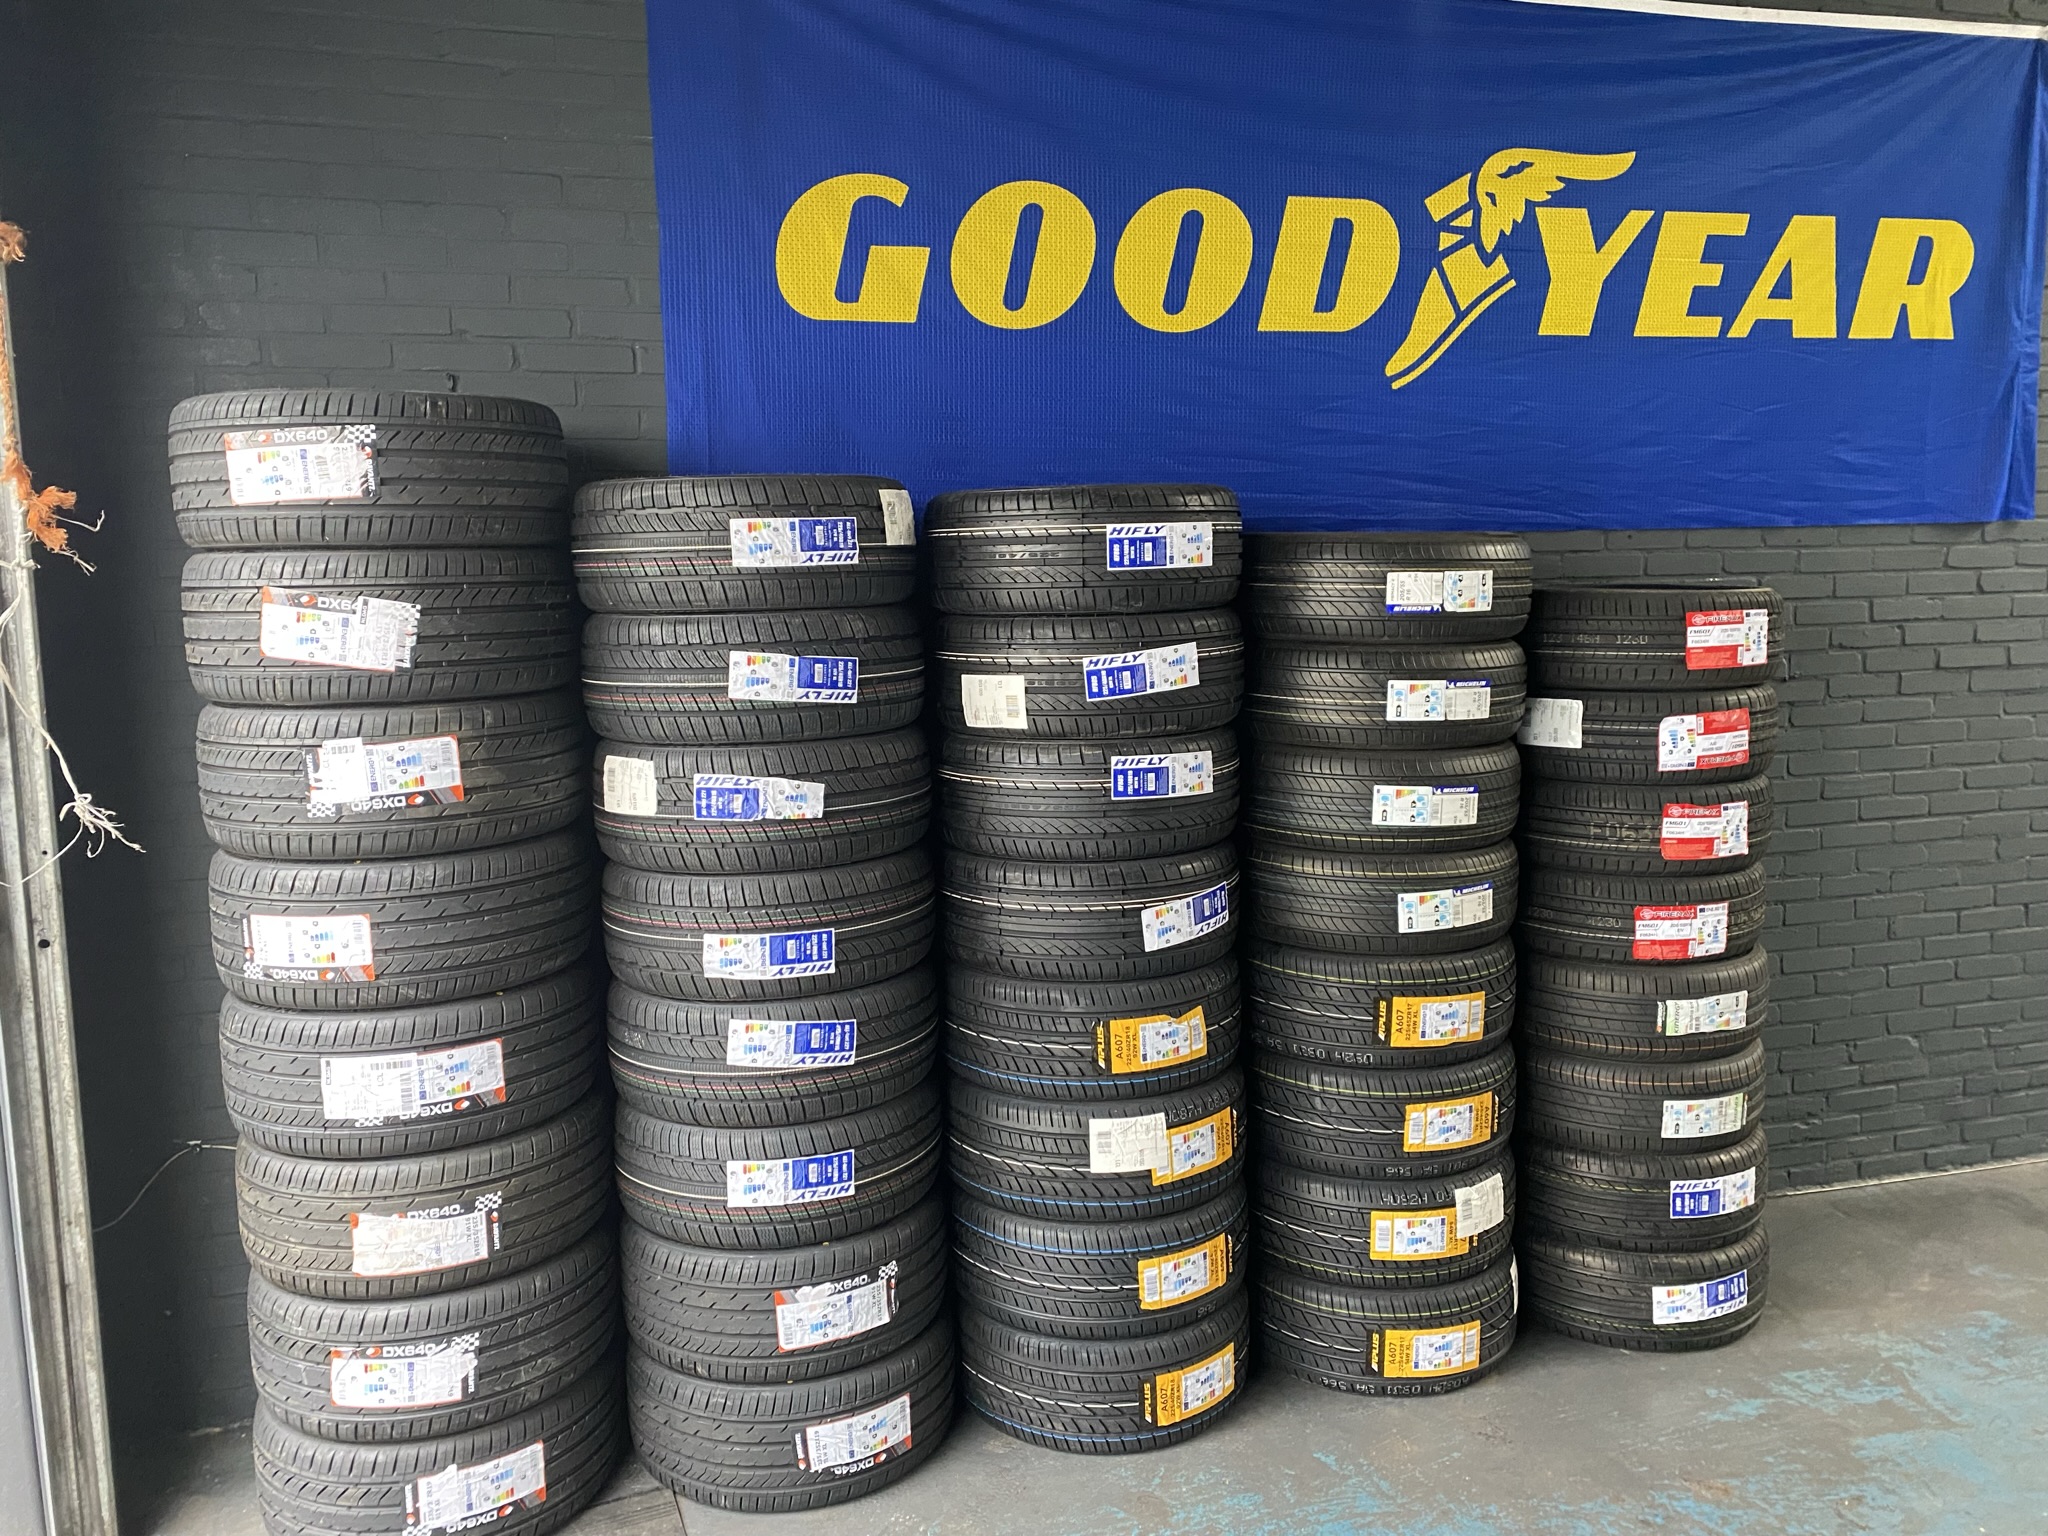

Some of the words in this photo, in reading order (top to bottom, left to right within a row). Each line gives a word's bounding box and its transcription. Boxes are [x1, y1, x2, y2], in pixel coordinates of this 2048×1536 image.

[274, 430, 328, 443] DX640
[1109, 525, 1166, 535] HIFLY
[801, 553, 857, 563] HIFLY
[1086, 653, 1143, 668] HIFLY
[797, 691, 855, 699] HIFLY
[1114, 756, 1169, 766] HIFLY
[696, 777, 758, 786] HIFLY
[351, 796, 406, 812] DX640
[1462, 884, 1489, 894] MICHELIN
[1196, 913, 1227, 935] HIFLY
[273, 969, 318, 980] DX640
[772, 962, 833, 976] HIFLY
[1413, 1010, 1418, 1019] XL
[1396, 1010, 1404, 1033] A607
[1132, 1033, 1137, 1041] XL
[1115, 1034, 1123, 1059] A607
[792, 1054, 852, 1064] HIFLY
[1673, 1180, 1719, 1190] HIFLY
[792, 1184, 852, 1201] HIFLY
[1709, 1297, 1745, 1317] HIFLY
[383, 1344, 436, 1357] DX640
[1388, 1342, 1396, 1364] A607
[1160, 1389, 1168, 1412] A607
[834, 1457, 874, 1474] DX640
[446, 1510, 498, 1533] DX640
